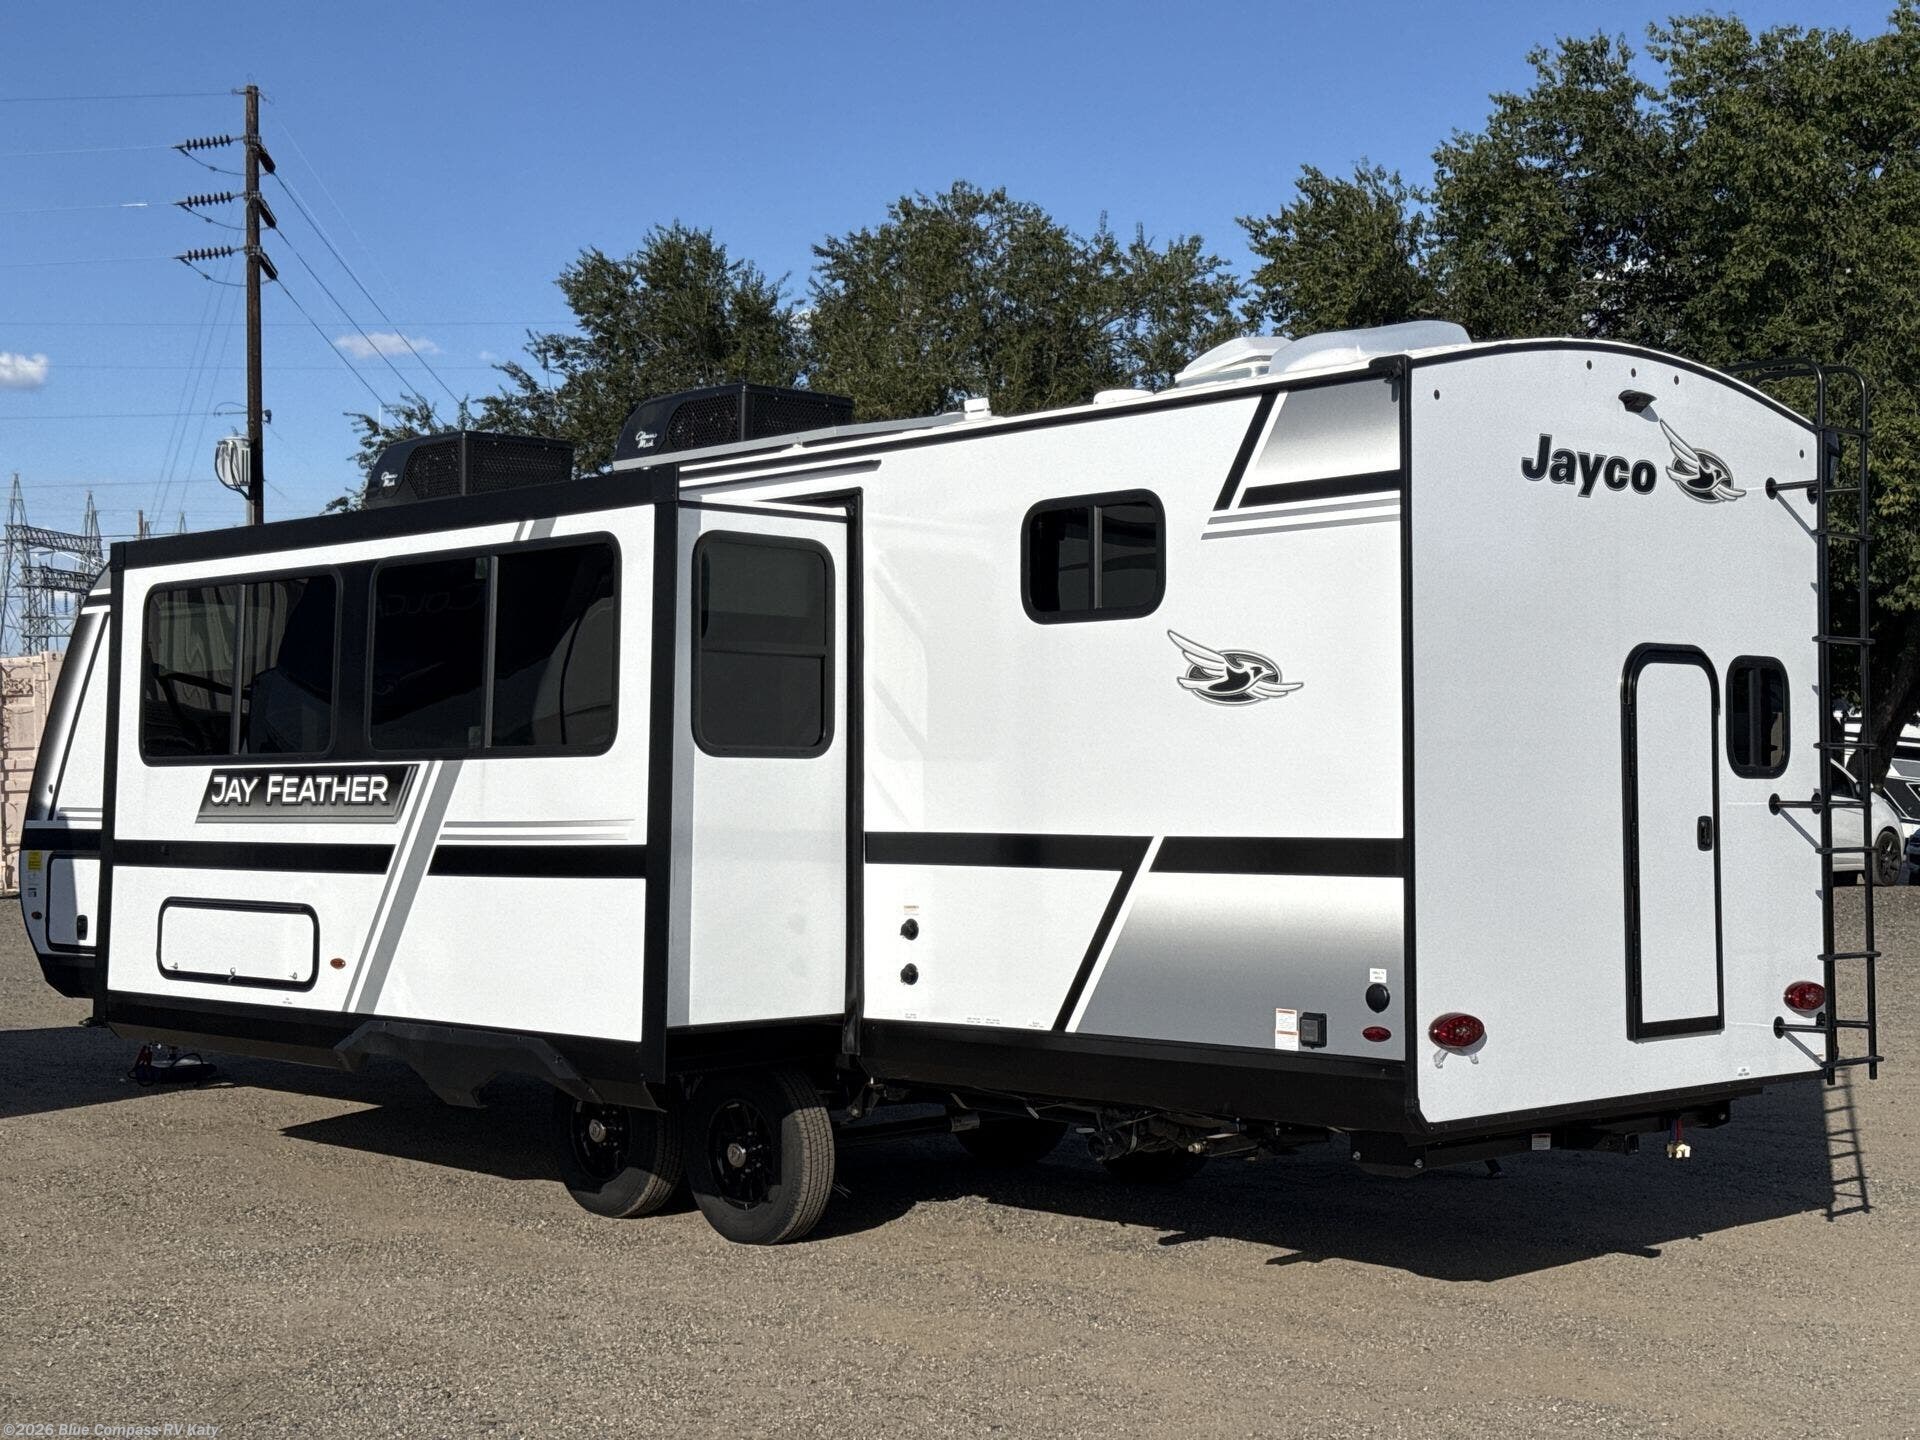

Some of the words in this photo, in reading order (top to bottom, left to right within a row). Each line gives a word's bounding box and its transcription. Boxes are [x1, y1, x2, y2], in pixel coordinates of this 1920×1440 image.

[1521, 433, 1657, 498] Jayco
[211, 775, 260, 805] JAY
[266, 774, 389, 805] FEATHER
